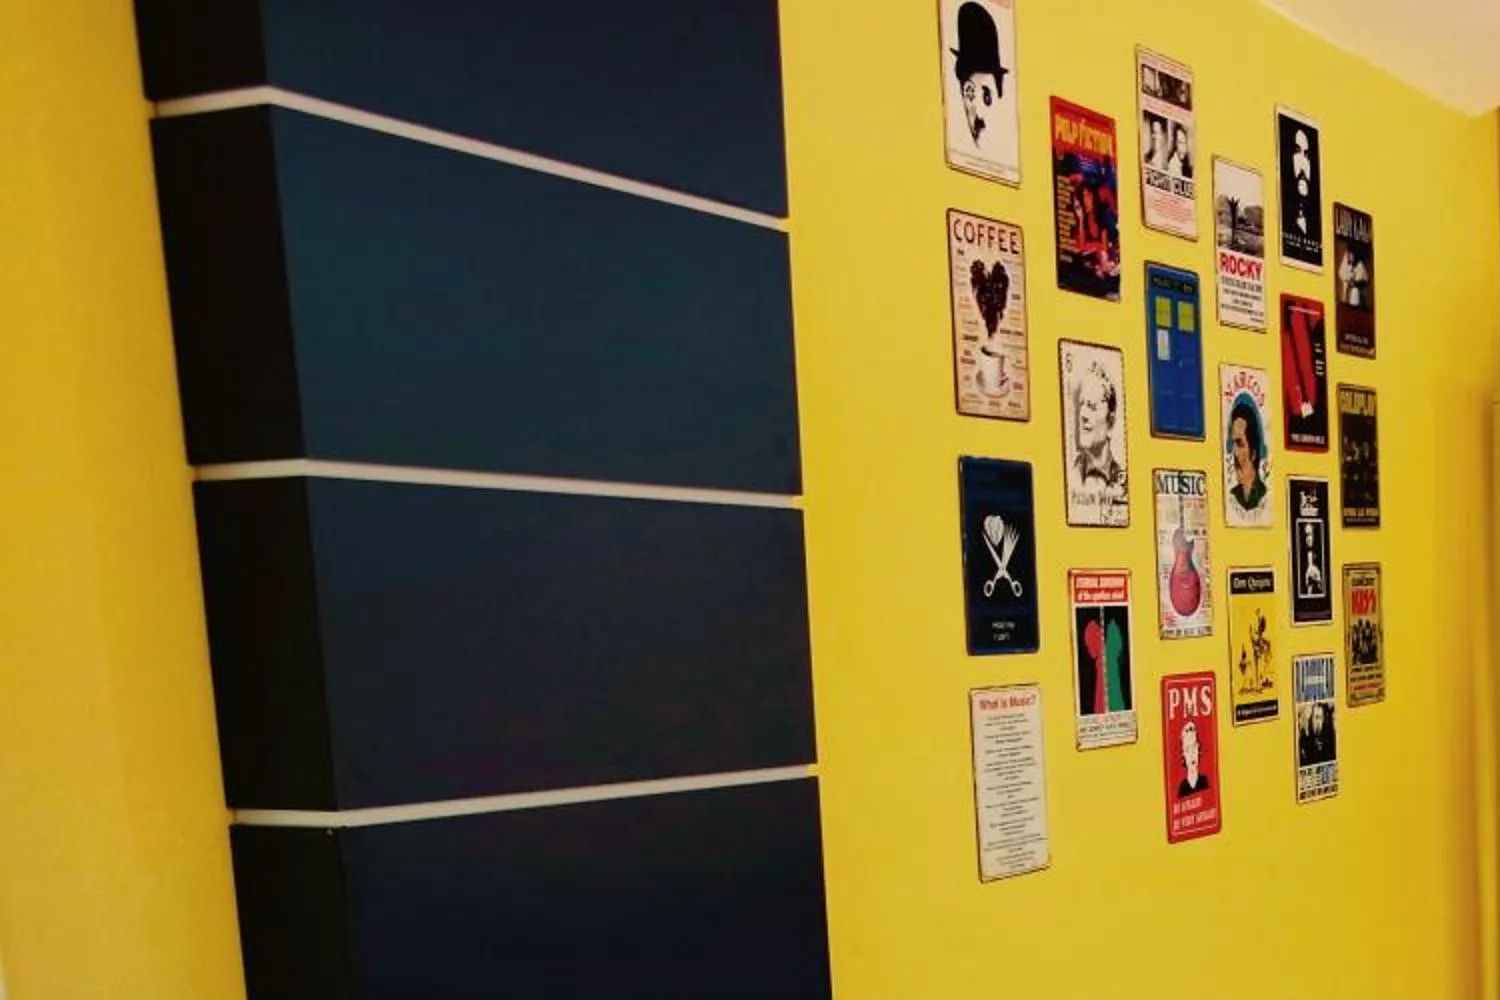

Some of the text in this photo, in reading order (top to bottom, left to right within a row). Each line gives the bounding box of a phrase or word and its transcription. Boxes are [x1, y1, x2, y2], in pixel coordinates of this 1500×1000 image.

[954, 219, 1019, 254] COFFEE
[1220, 252, 1263, 281] ROCKY
[1155, 473, 1206, 496] MUSIC
[1168, 686, 1212, 719] PMS
